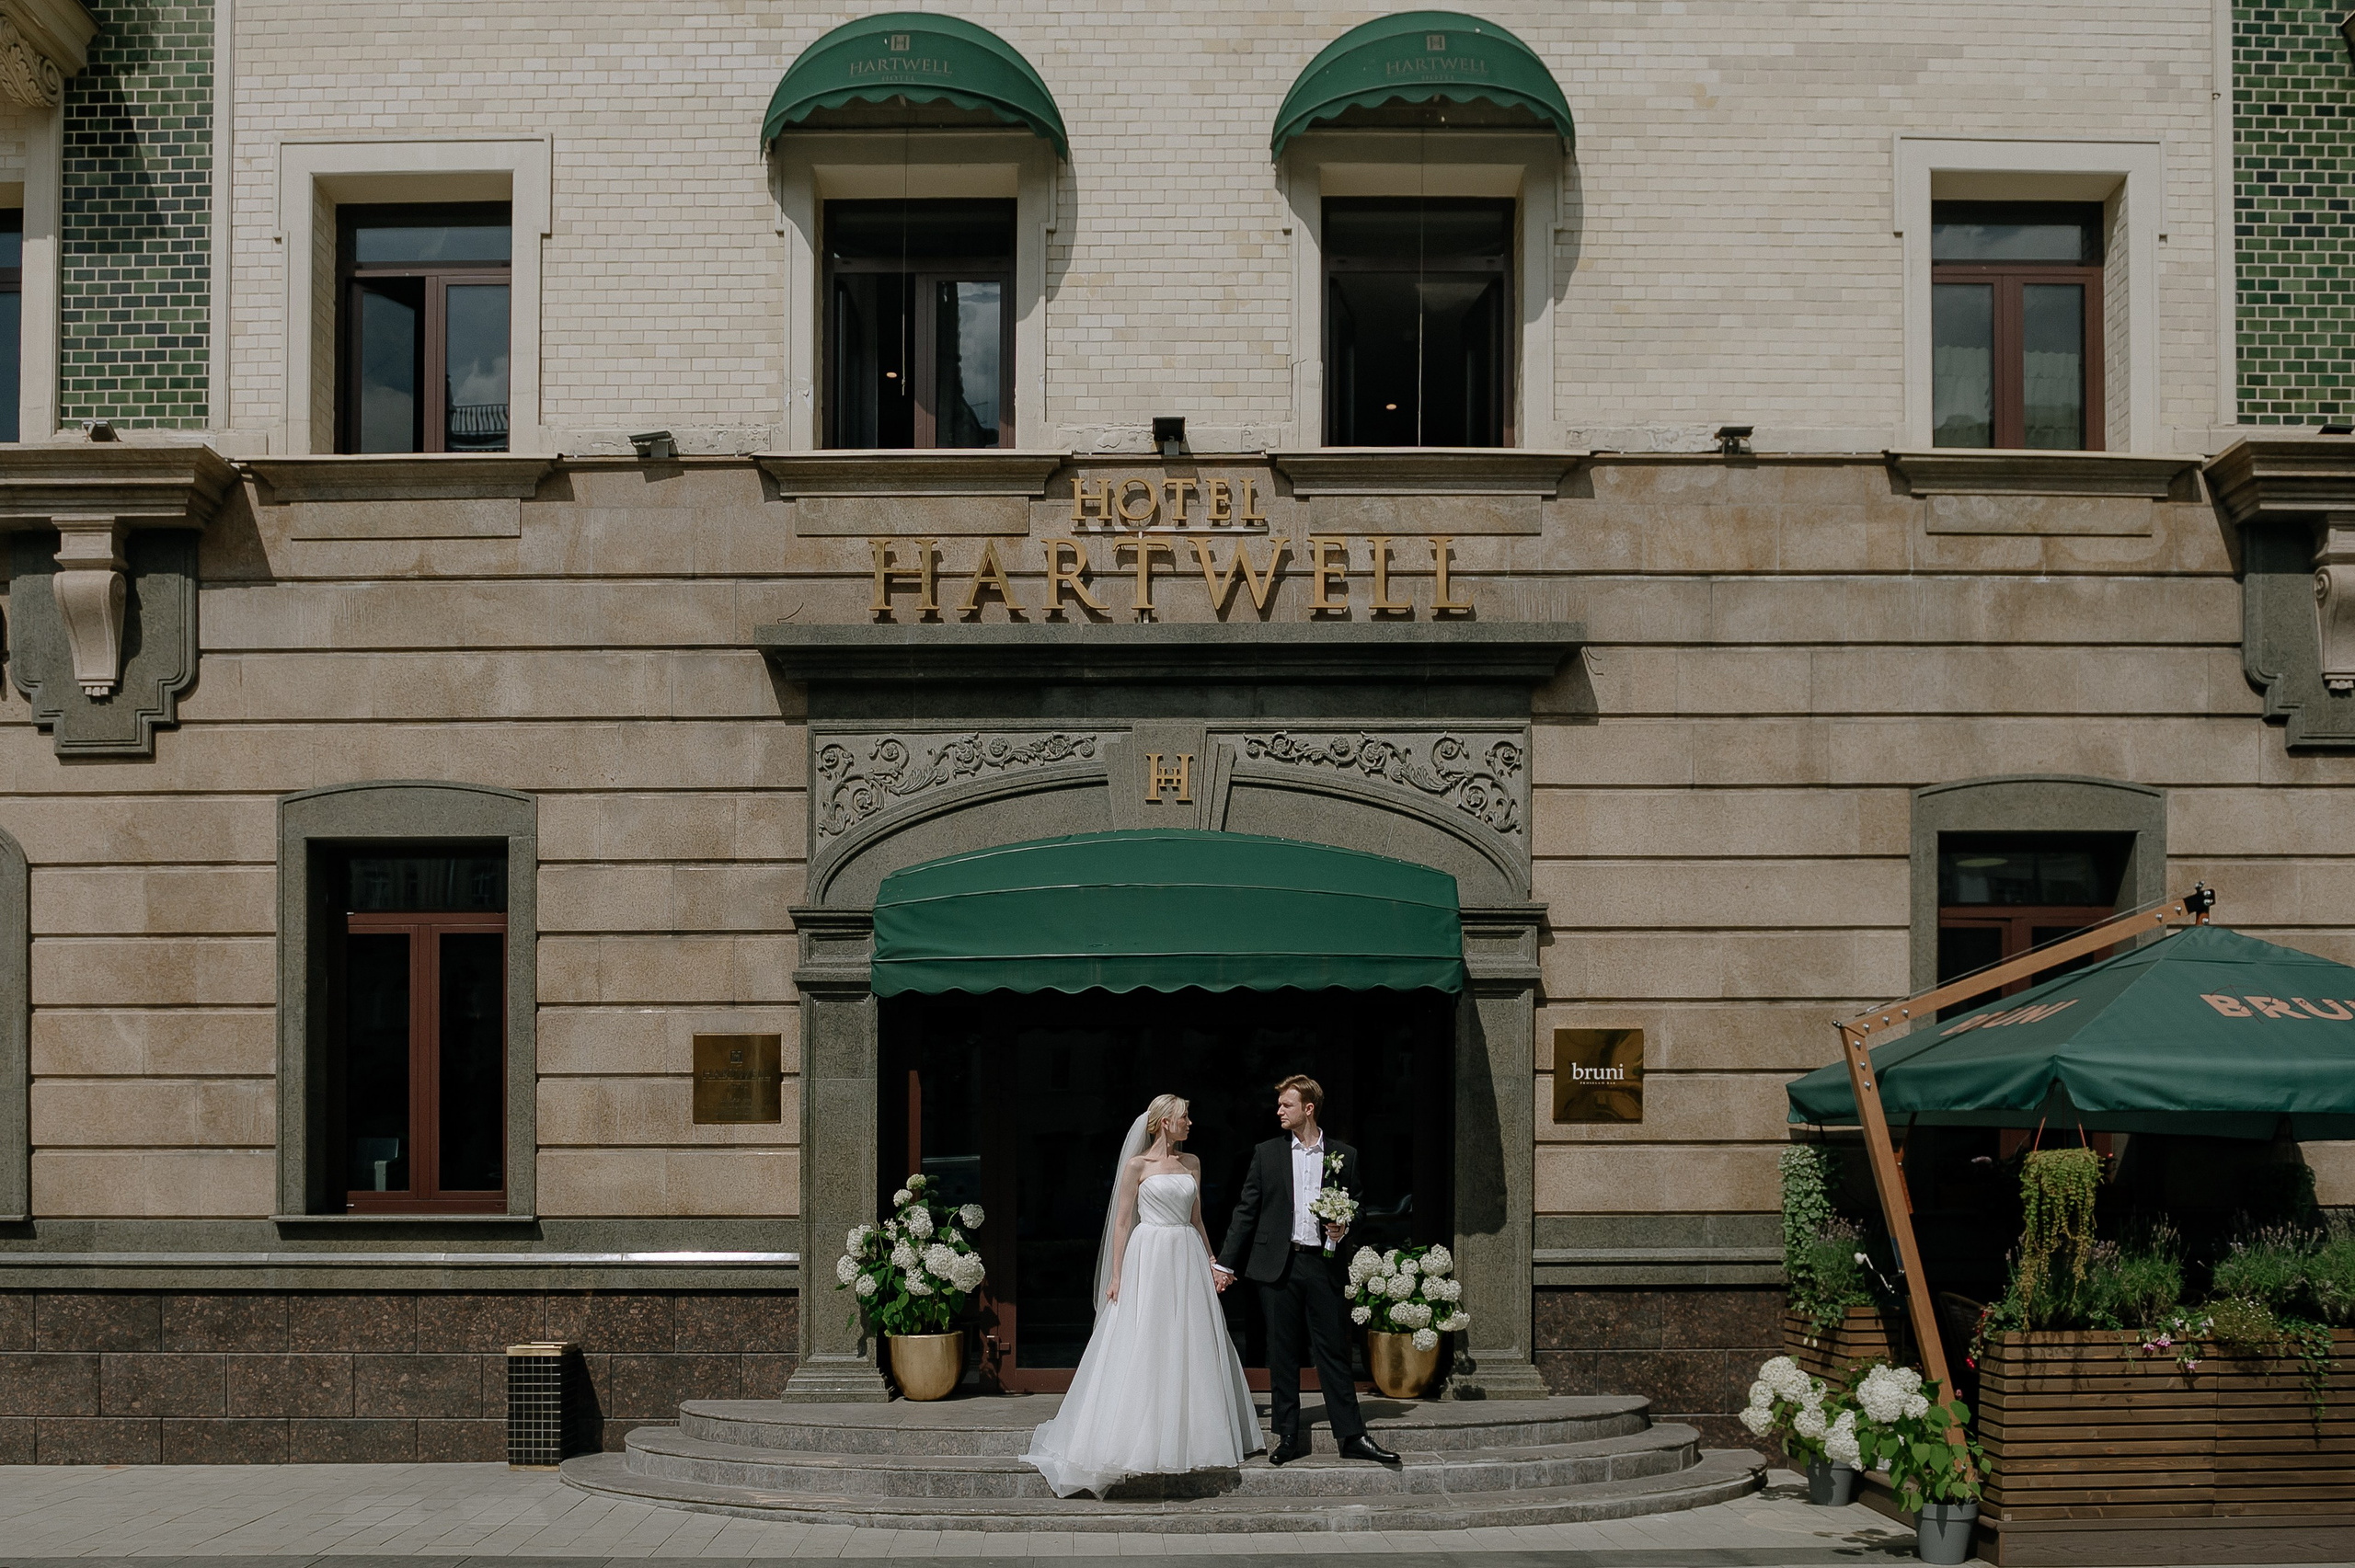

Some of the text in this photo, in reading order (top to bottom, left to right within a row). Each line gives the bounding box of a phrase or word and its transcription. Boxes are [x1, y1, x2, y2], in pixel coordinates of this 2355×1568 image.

[849, 57, 953, 76] HARTWELL
[1385, 57, 1489, 75] HARTWELL
[1070, 477, 1267, 521] HOTEL
[868, 537, 1474, 611] HARTWELL
[2200, 993, 2355, 1021] BRU
[1571, 1062, 1625, 1080] bruni
